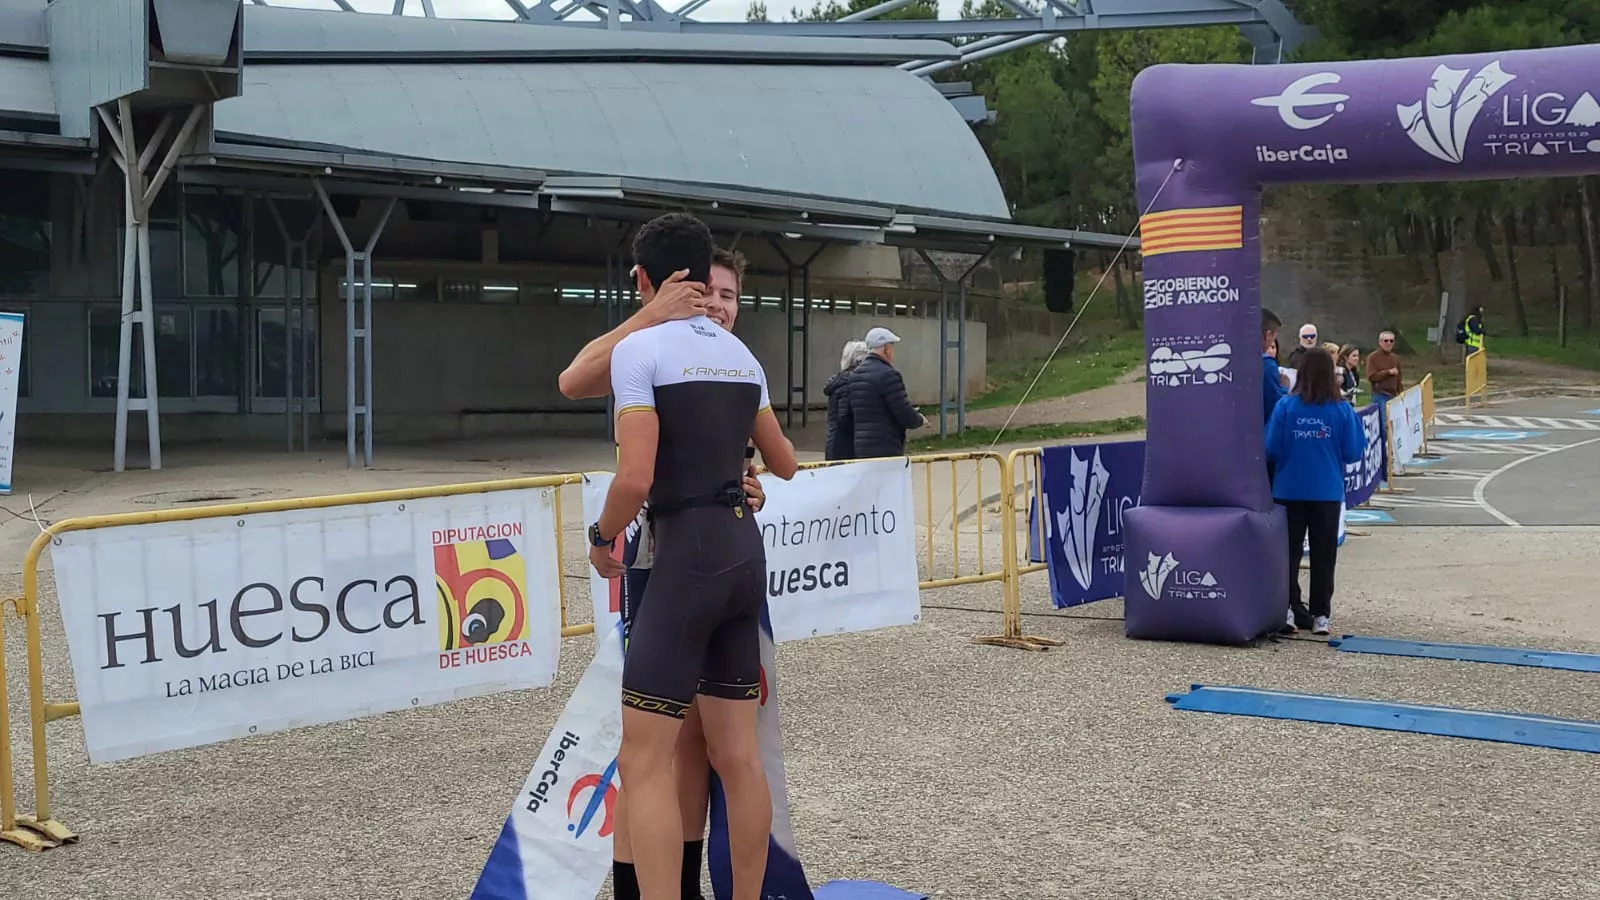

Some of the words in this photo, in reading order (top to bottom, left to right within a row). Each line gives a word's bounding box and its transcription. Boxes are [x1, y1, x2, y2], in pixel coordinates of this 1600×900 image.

[1503, 91, 1600, 128] LIGA
[1488, 131, 1589, 140] aragonesa
[1255, 144, 1348, 164] iberCaja
[1157, 275, 1229, 292] GOBIERNO
[1156, 292, 1173, 306] DE
[1150, 371, 1233, 387] TRIATLON
[432, 522, 522, 545] DIPUTACION
[1175, 570, 1218, 587] LIGA
[1168, 589, 1227, 599] TRIATLON
[97, 574, 426, 670] Huesca
[340, 651, 375, 670] BICI
[439, 652, 461, 669] DE
[465, 641, 532, 665] HUESCA
[526, 730, 580, 814] iberCaja
